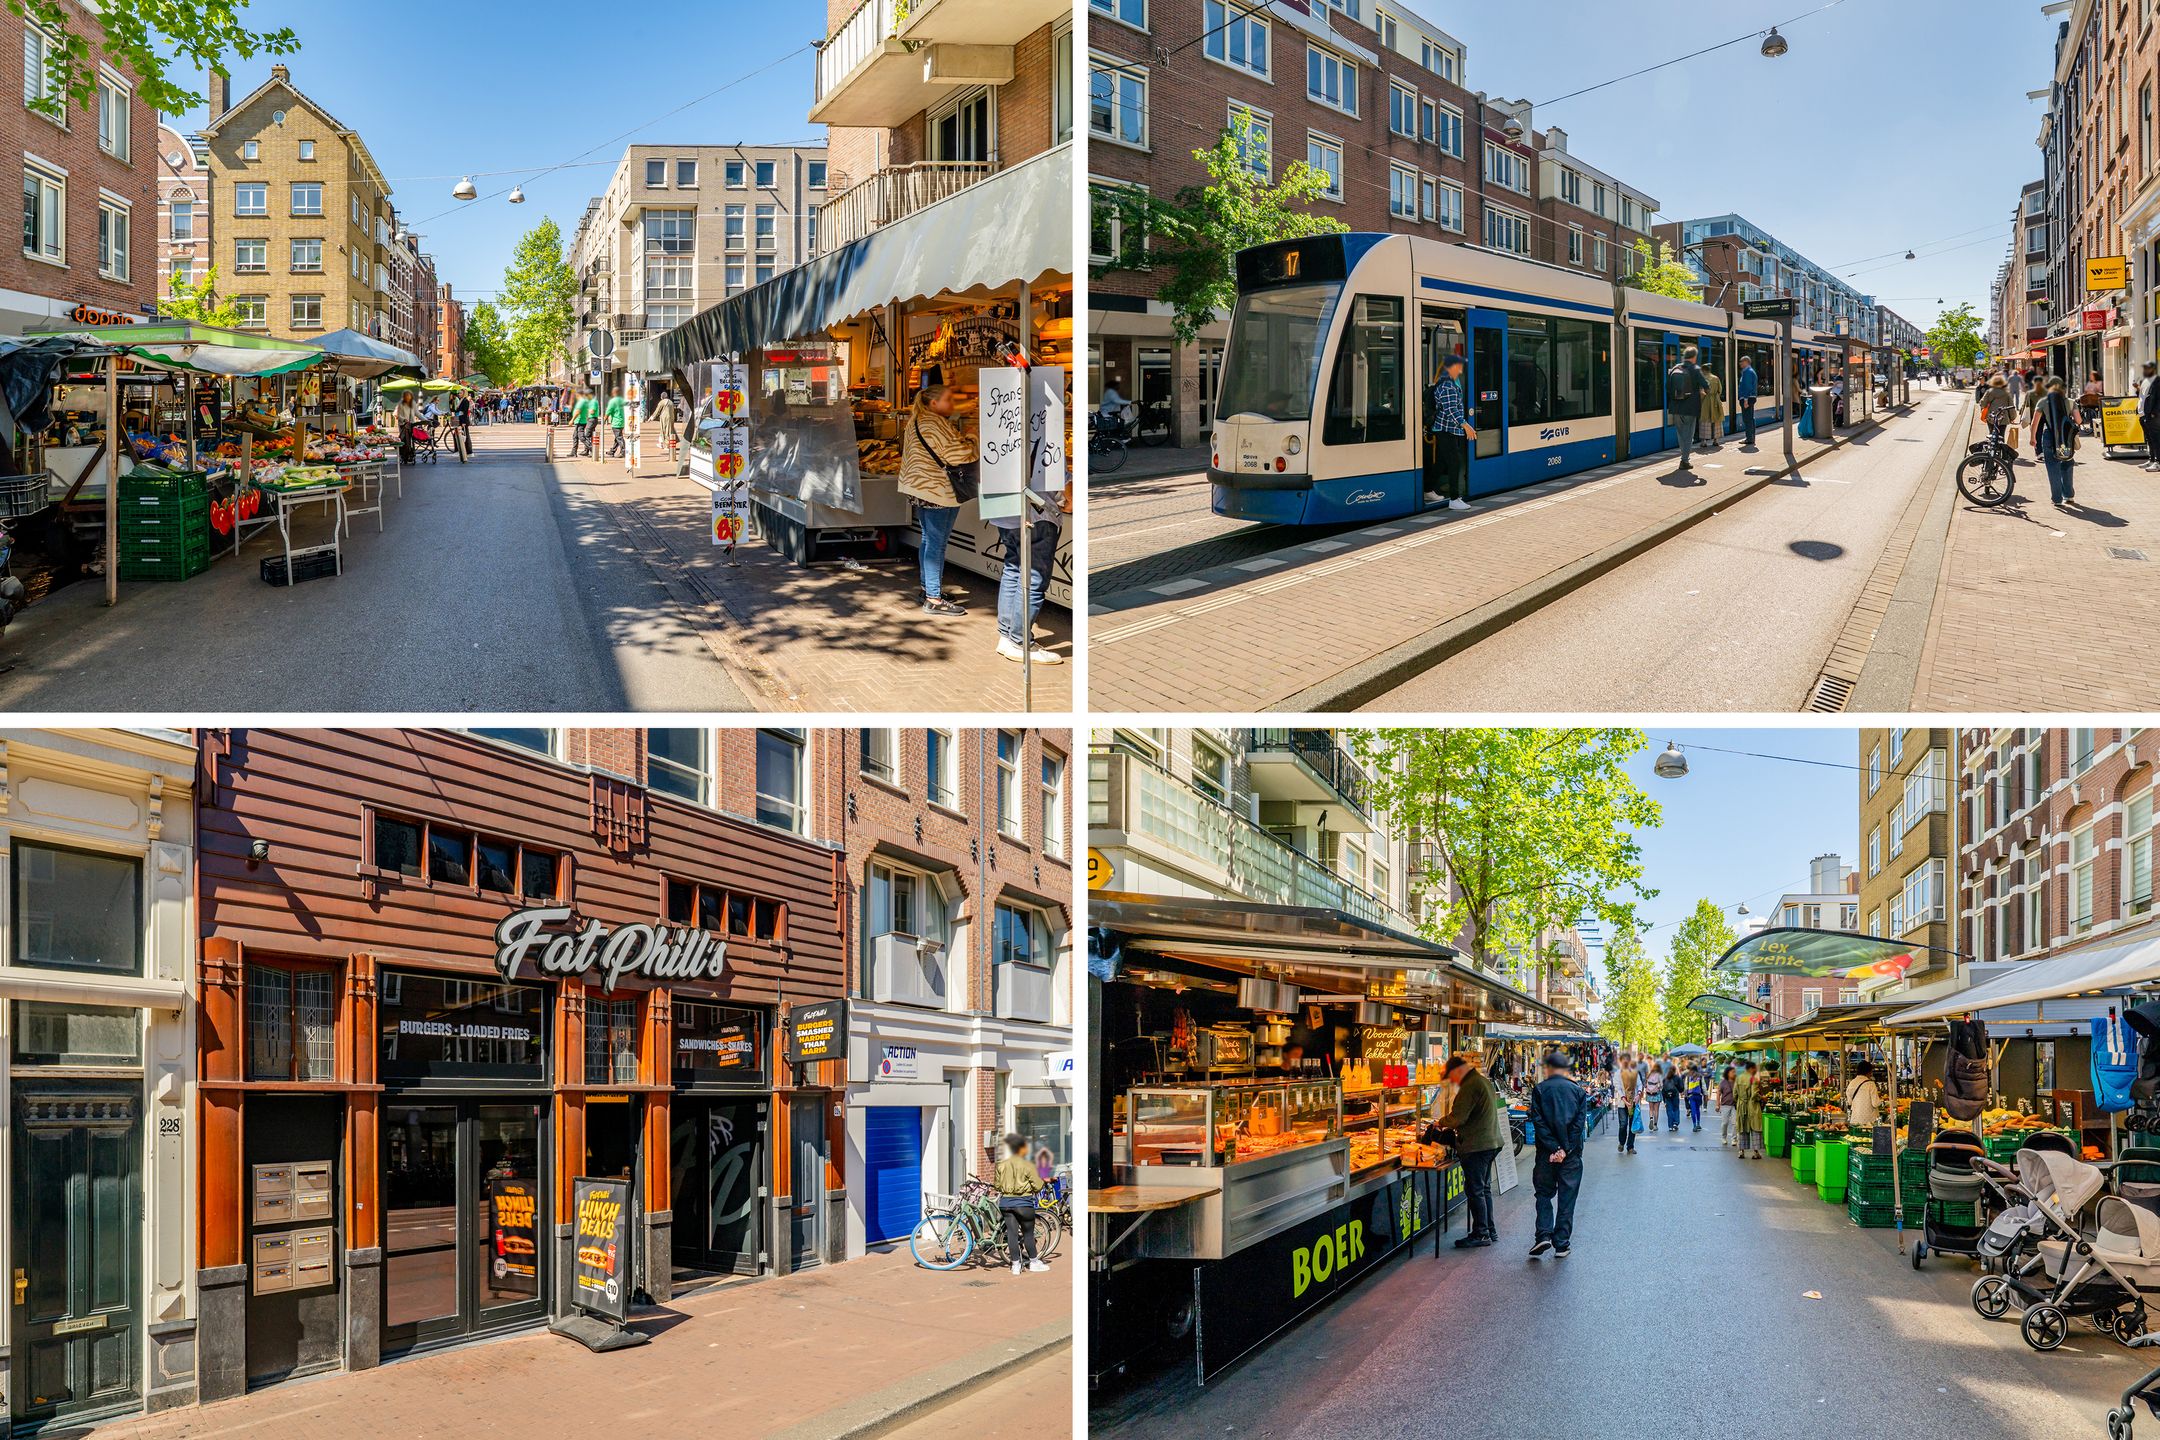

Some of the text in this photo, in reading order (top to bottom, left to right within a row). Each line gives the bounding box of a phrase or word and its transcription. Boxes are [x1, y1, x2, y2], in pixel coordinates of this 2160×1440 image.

[1286, 251, 1299, 276] 17
[1554, 426, 1570, 437] GVB
[1547, 456, 1562, 466] 2068
[495, 906, 728, 994] Fat Phill's
[400, 1020, 530, 1041] BURGERS LOADED FRIES
[797, 1020, 833, 1031] BURGERS
[796, 1027, 834, 1037] SMASHED
[799, 1034, 831, 1043] HARDER
[1376, 1039, 1393, 1048] wat
[680, 1039, 723, 1051] SANDWICHES
[728, 1041, 753, 1052] SHAKES
[803, 1041, 825, 1049] THAN
[801, 1047, 827, 1056] MARIO
[888, 1045, 917, 1060] ACTION
[1365, 1048, 1391, 1059] lekker
[160, 1117, 180, 1133] 228
[578, 1199, 621, 1222] LUNCH
[580, 1217, 615, 1240] DEALS
[1293, 1219, 1366, 1299] BOER
